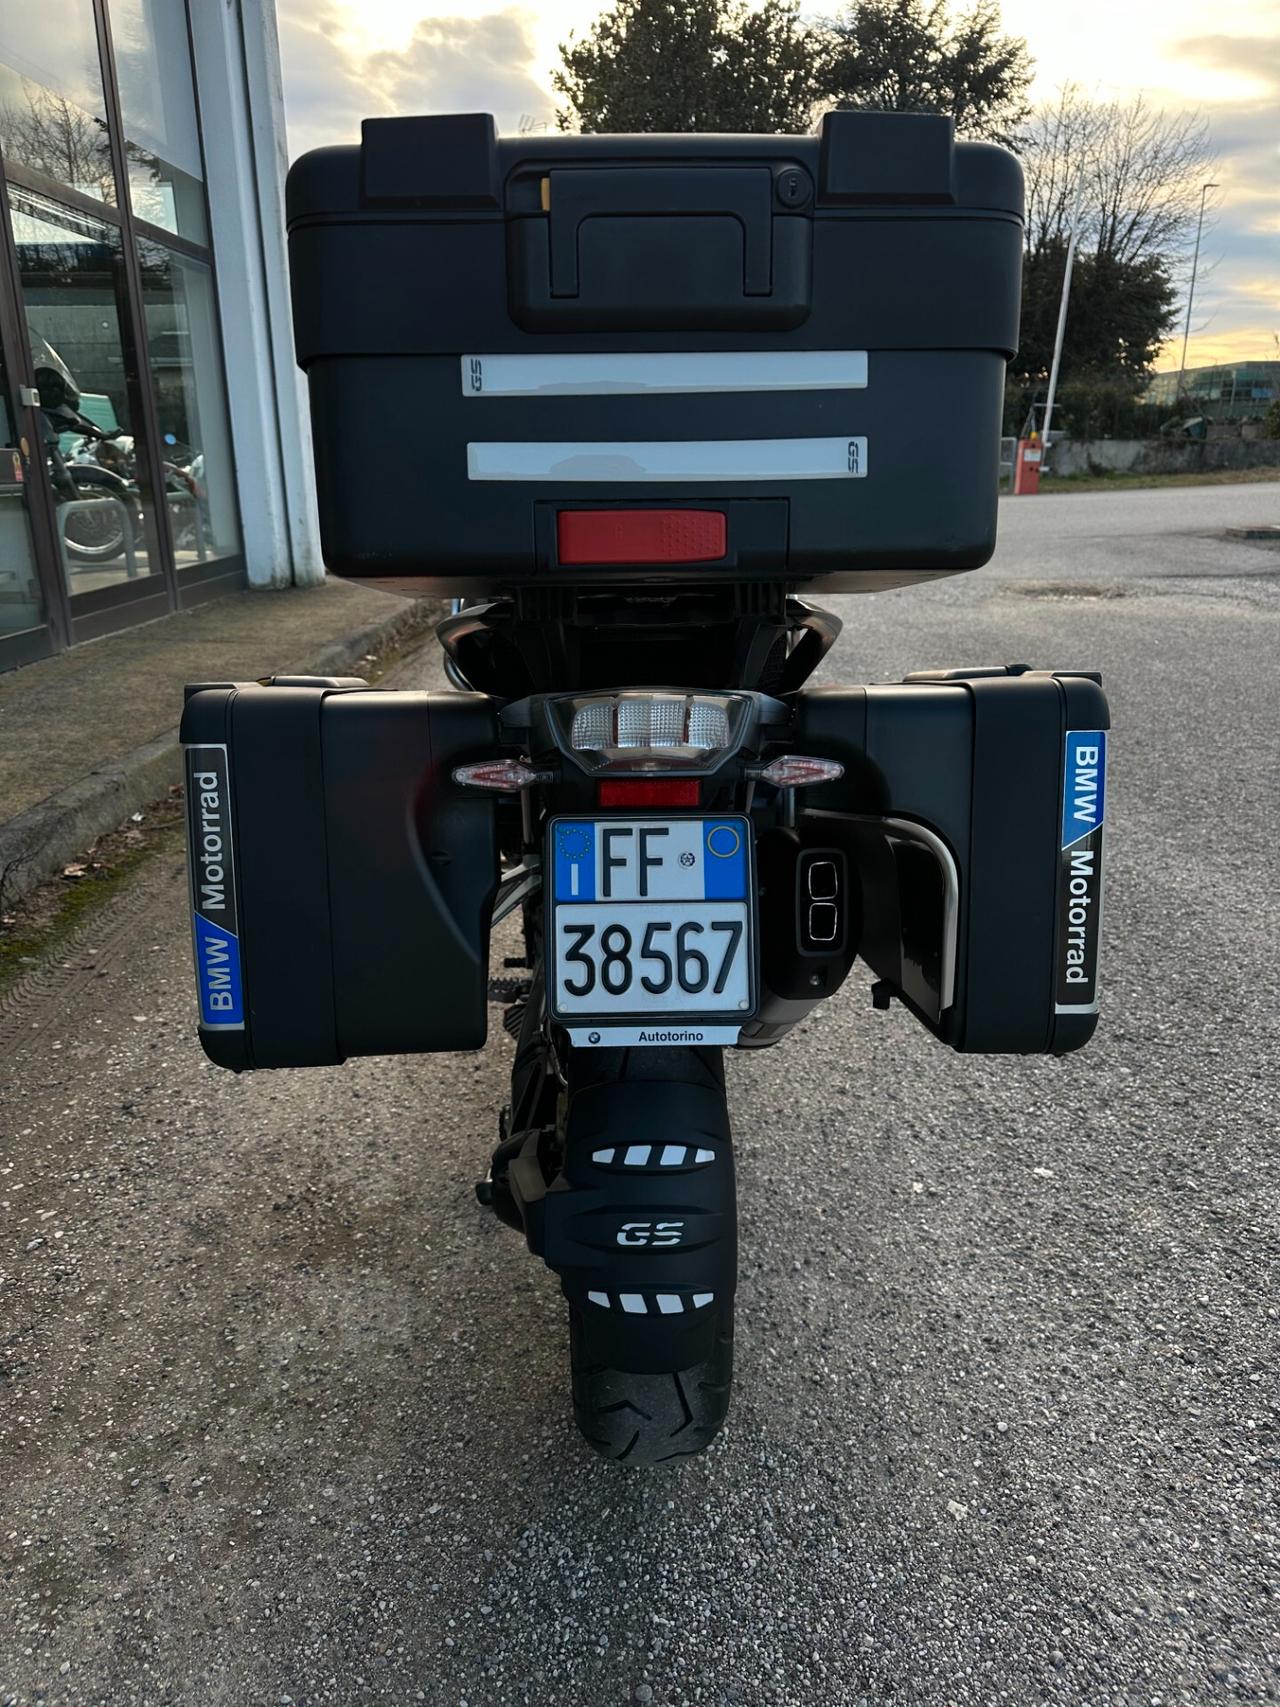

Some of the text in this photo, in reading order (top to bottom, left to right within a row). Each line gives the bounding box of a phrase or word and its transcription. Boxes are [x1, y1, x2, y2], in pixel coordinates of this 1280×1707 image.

[471, 359, 482, 391] GS
[848, 441, 859, 473] GS
[602, 828, 669, 897] FF
[1066, 746, 1099, 984] BMW Motorrad
[193, 771, 234, 1011] BMW Motorrad
[563, 921, 743, 997] 38567
[638, 1031, 704, 1043] Autotorino
[616, 1222, 685, 1246] GS
